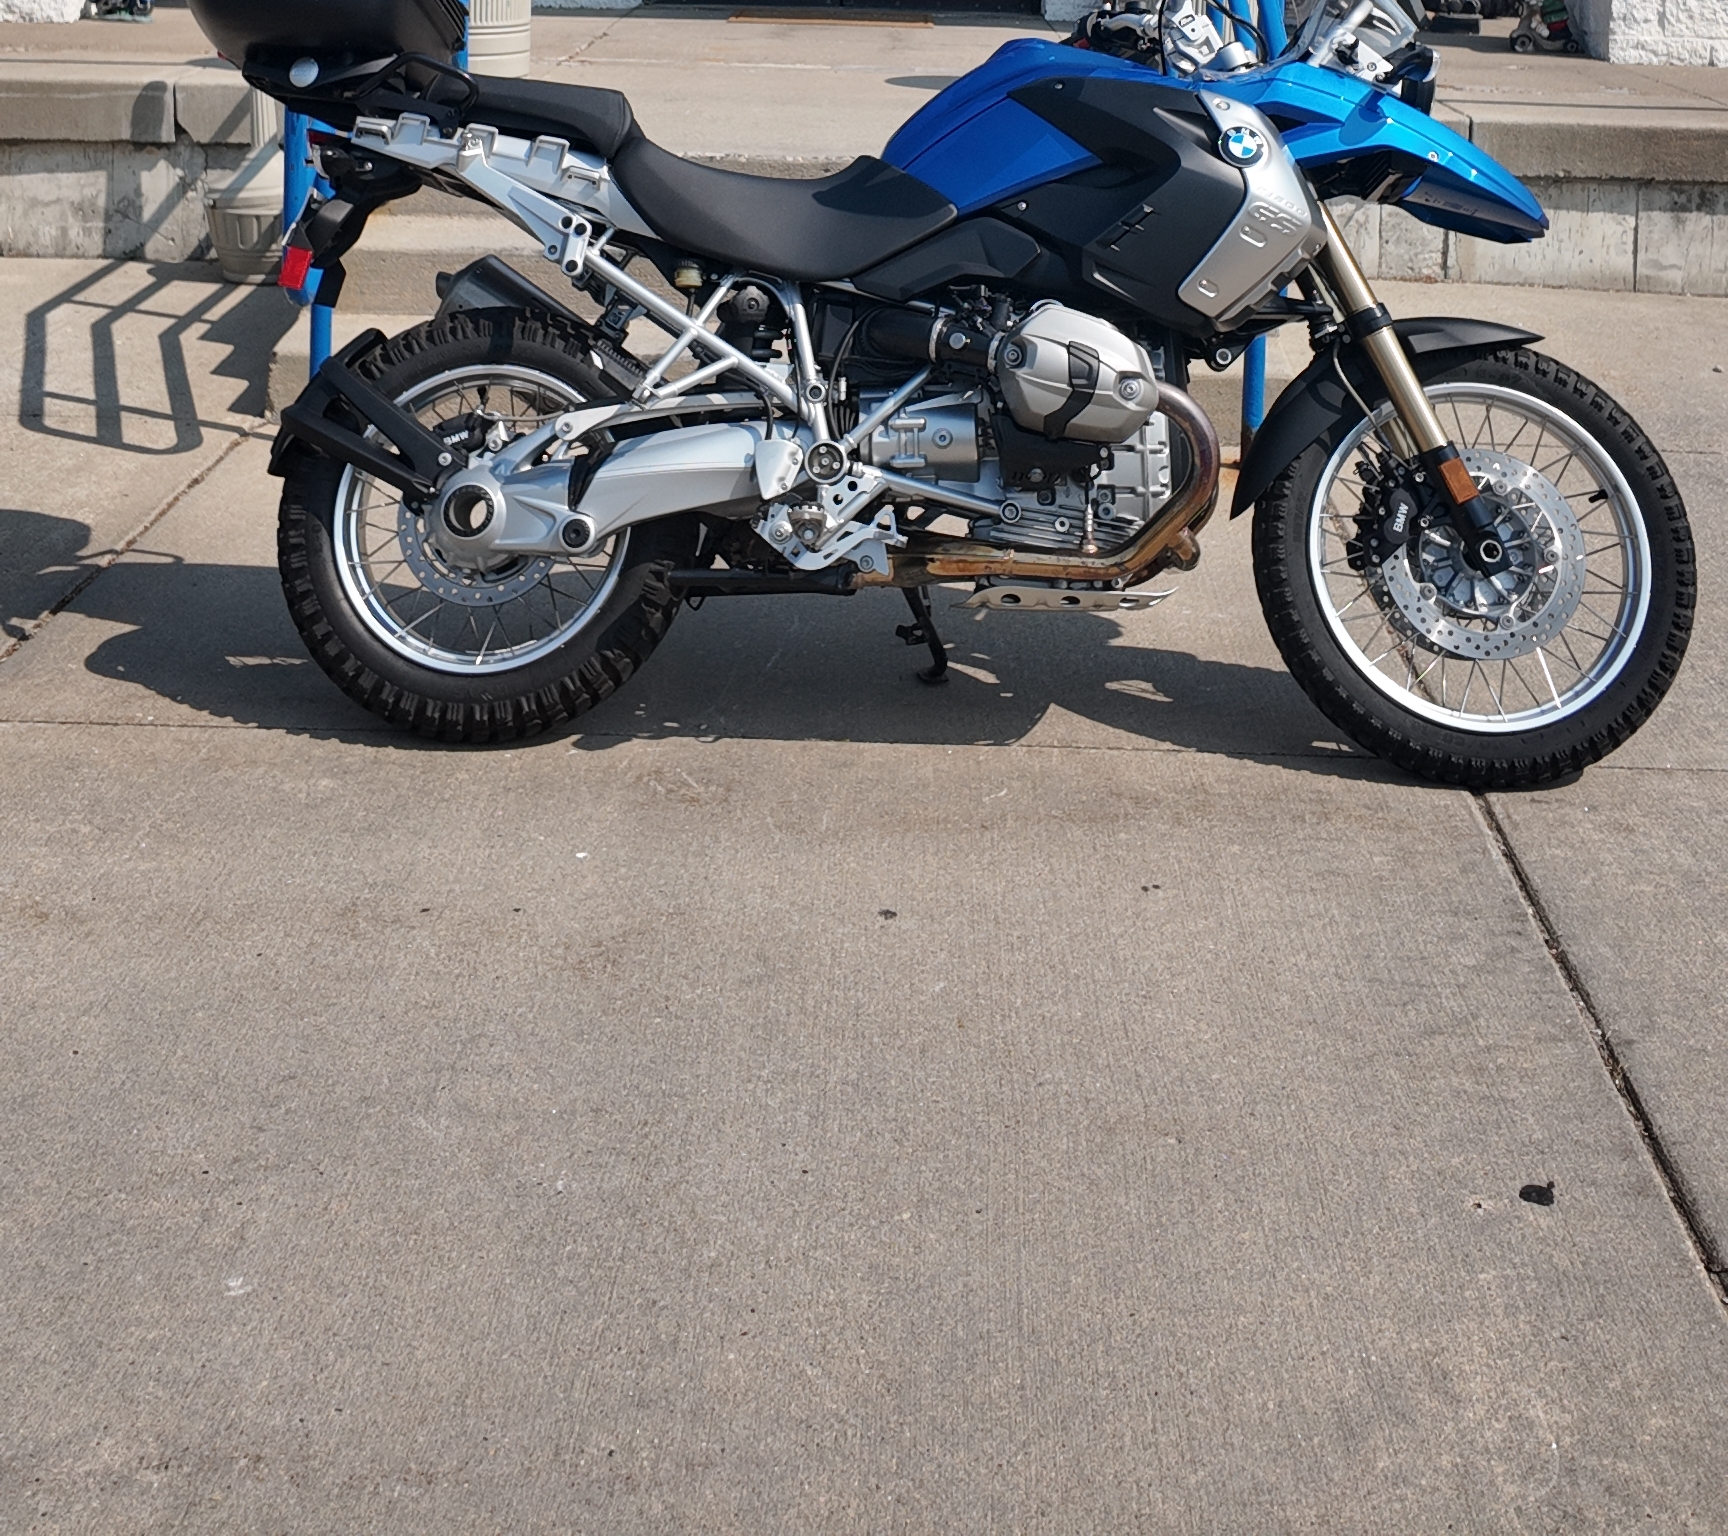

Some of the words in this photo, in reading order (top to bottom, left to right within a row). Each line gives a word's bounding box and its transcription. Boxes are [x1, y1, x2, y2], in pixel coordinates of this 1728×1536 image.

[1226, 127, 1264, 145] BMW
[443, 429, 469, 445] BMW
[1392, 502, 1409, 533] BMW
